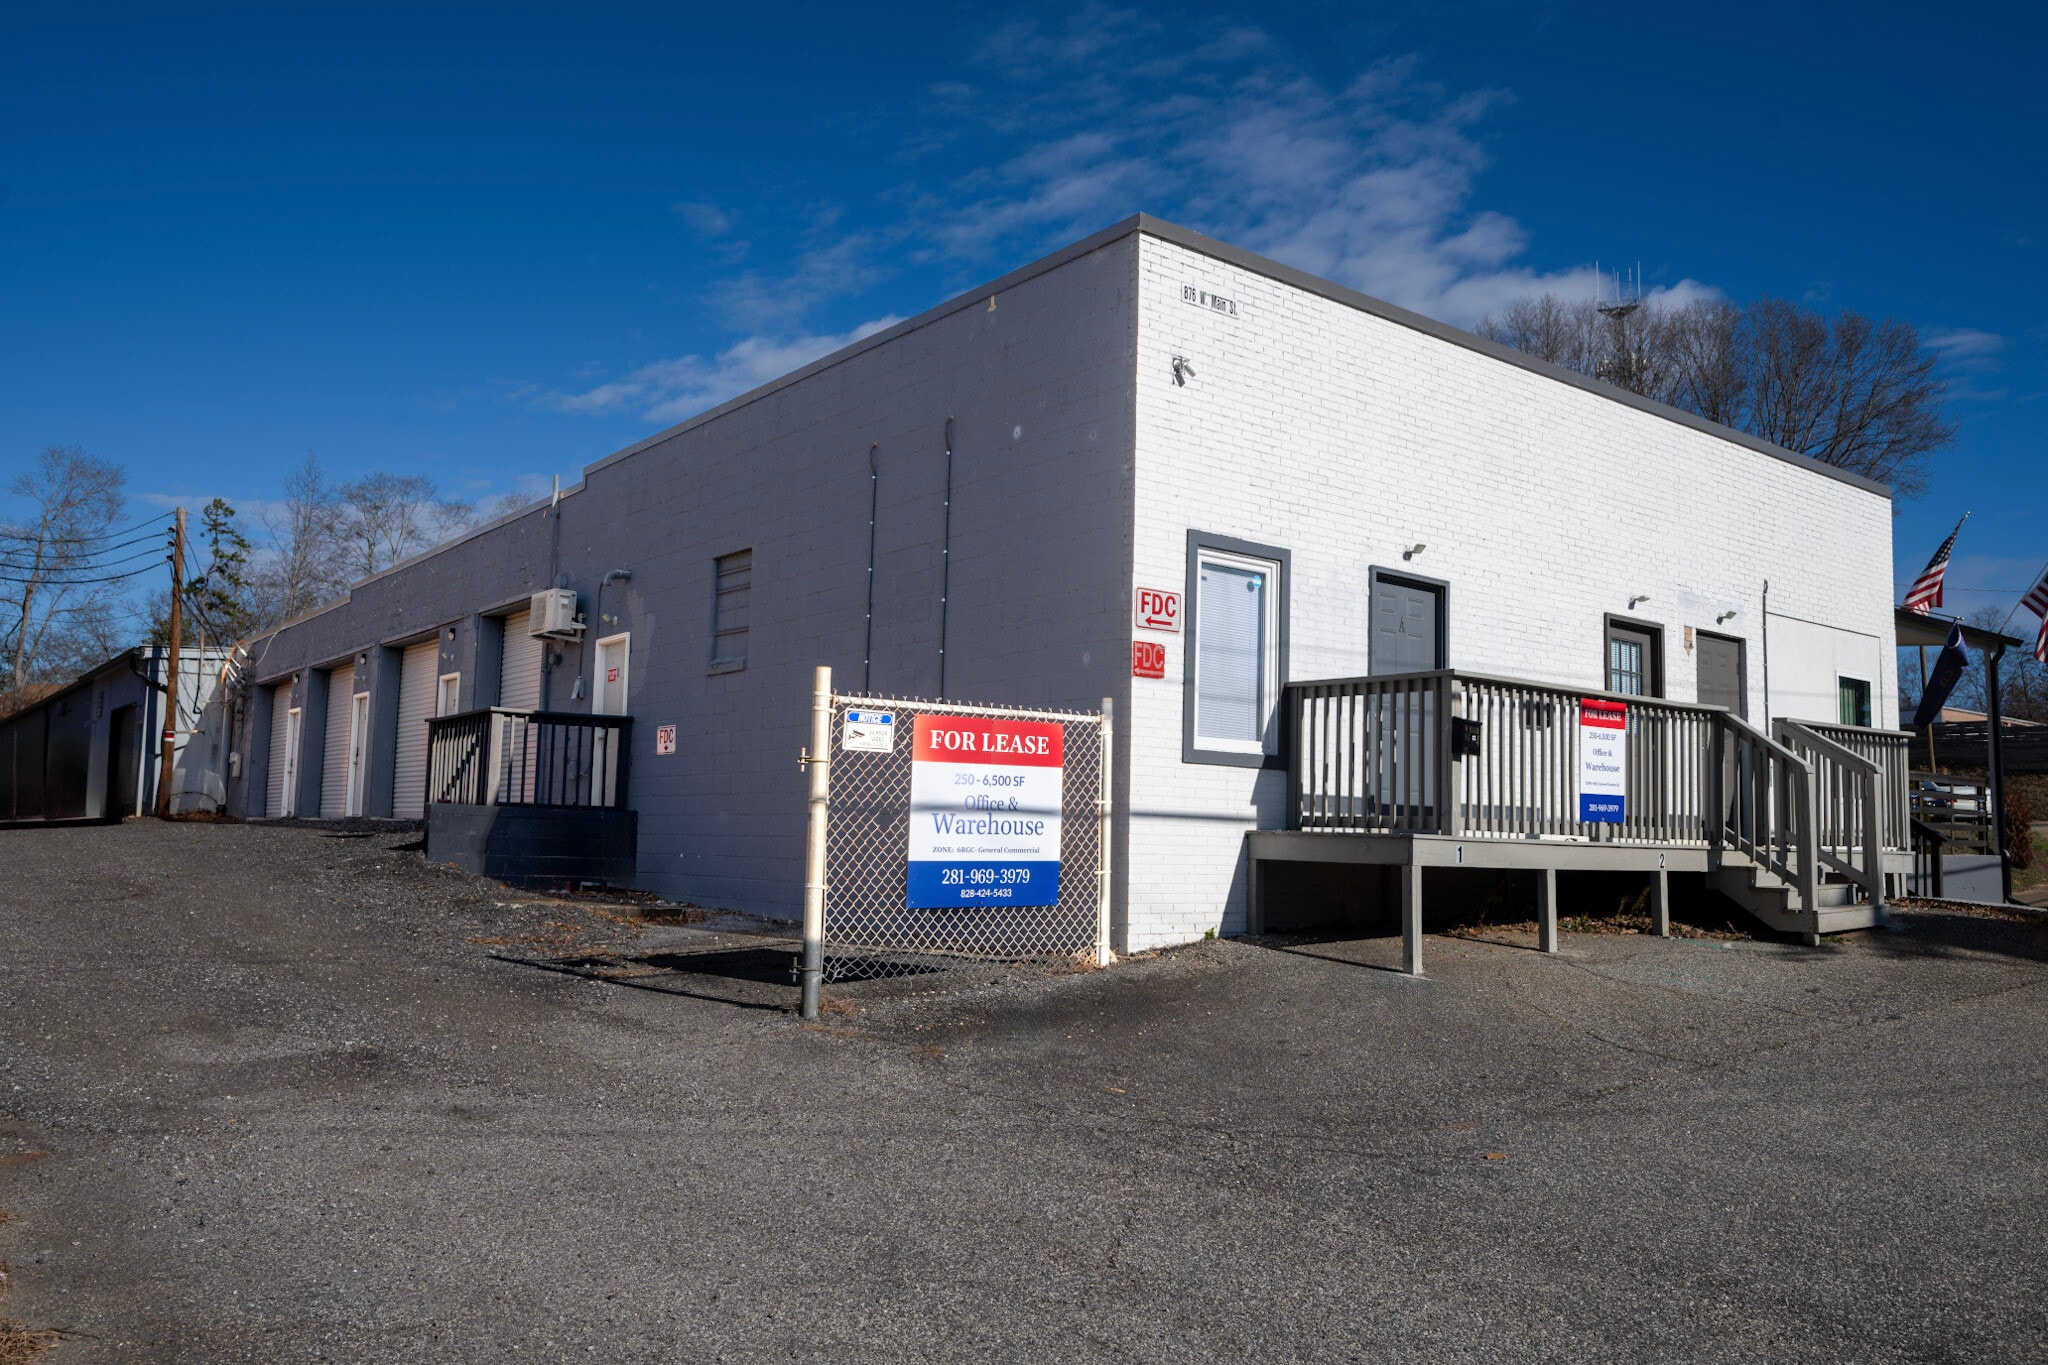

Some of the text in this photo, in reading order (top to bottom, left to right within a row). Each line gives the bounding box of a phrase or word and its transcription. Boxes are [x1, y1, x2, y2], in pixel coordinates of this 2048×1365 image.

[1211, 294, 1226, 312] Main
[1140, 591, 1176, 618] FDC
[1134, 643, 1164, 669] FDC
[659, 728, 674, 744] FDC
[930, 729, 1049, 755] FOR LEASE
[1585, 761, 1620, 773] Warehouse
[954, 773, 975, 786] 250
[982, 774, 1012, 788] 6,500
[1013, 775, 1026, 787] SF
[964, 794, 1019, 812] Office &
[931, 812, 1045, 836] Warehouse
[932, 846, 955, 854] ZONE:
[978, 846, 1003, 854] General
[1003, 847, 1040, 855] Commercial
[1457, 845, 1462, 864] 1
[1659, 853, 1665, 869] 2
[941, 868, 1031, 885] 281-969-3979
[960, 888, 1012, 898] 828-424-5433
